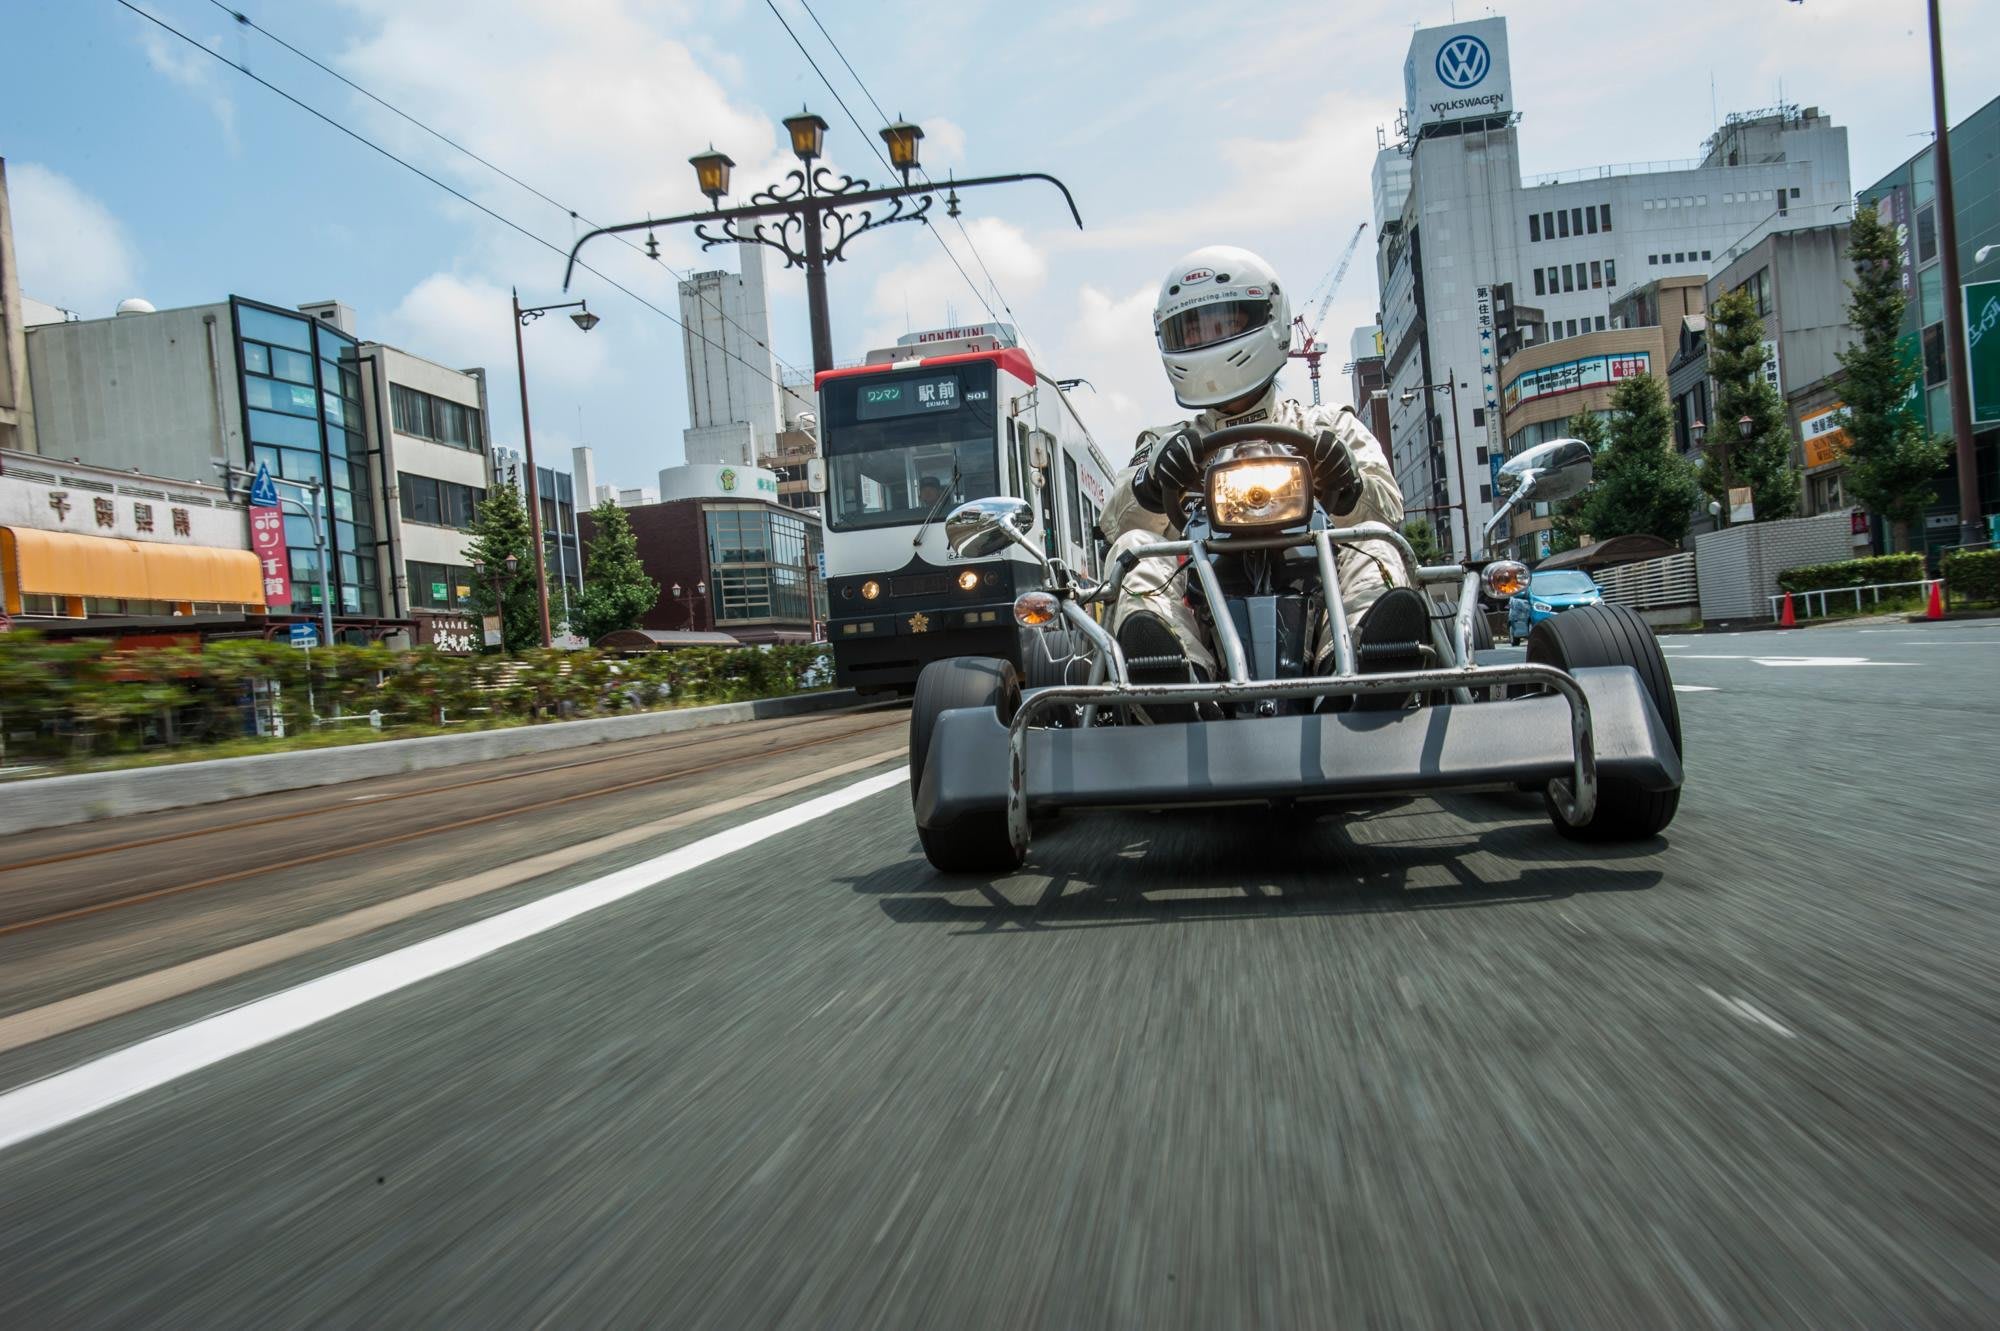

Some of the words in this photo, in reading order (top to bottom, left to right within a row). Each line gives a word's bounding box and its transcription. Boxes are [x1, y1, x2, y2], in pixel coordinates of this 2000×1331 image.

[1430, 94, 1504, 112] VOLKSWAGEN
[1185, 270, 1210, 282] BELL
[1476, 287, 1491, 326] 第一住宅
[867, 389, 900, 402] ワンマン
[918, 382, 955, 402] 駅前
[926, 399, 950, 408] EKIMAE
